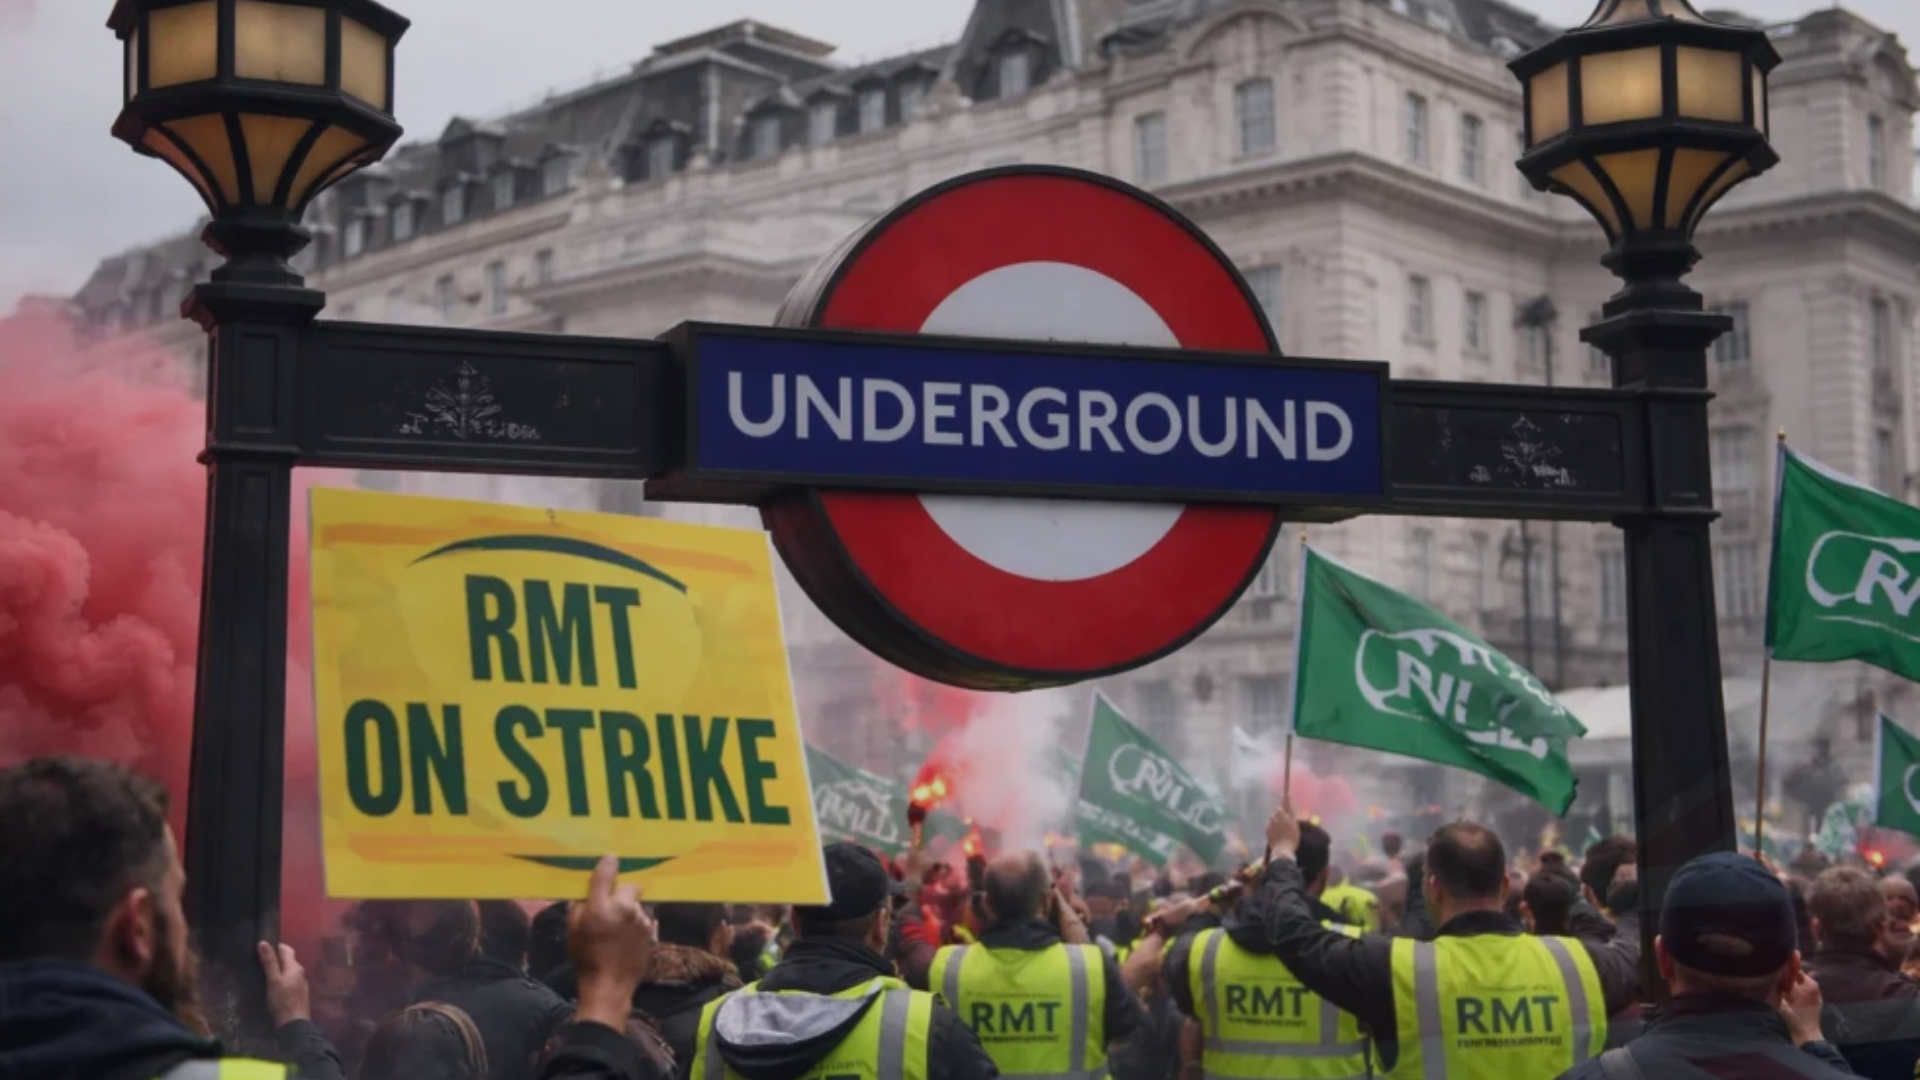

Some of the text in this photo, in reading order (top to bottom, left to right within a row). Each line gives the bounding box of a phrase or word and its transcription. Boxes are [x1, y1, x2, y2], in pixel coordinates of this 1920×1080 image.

[728, 371, 1353, 461] UNDERGROUND
[465, 573, 641, 689] RMT
[343, 698, 468, 817] ON
[493, 704, 791, 825] STRIKE
[972, 1002, 1061, 1033] RMT
[1226, 984, 1309, 1017] RMT
[1456, 996, 1559, 1034] RMT
